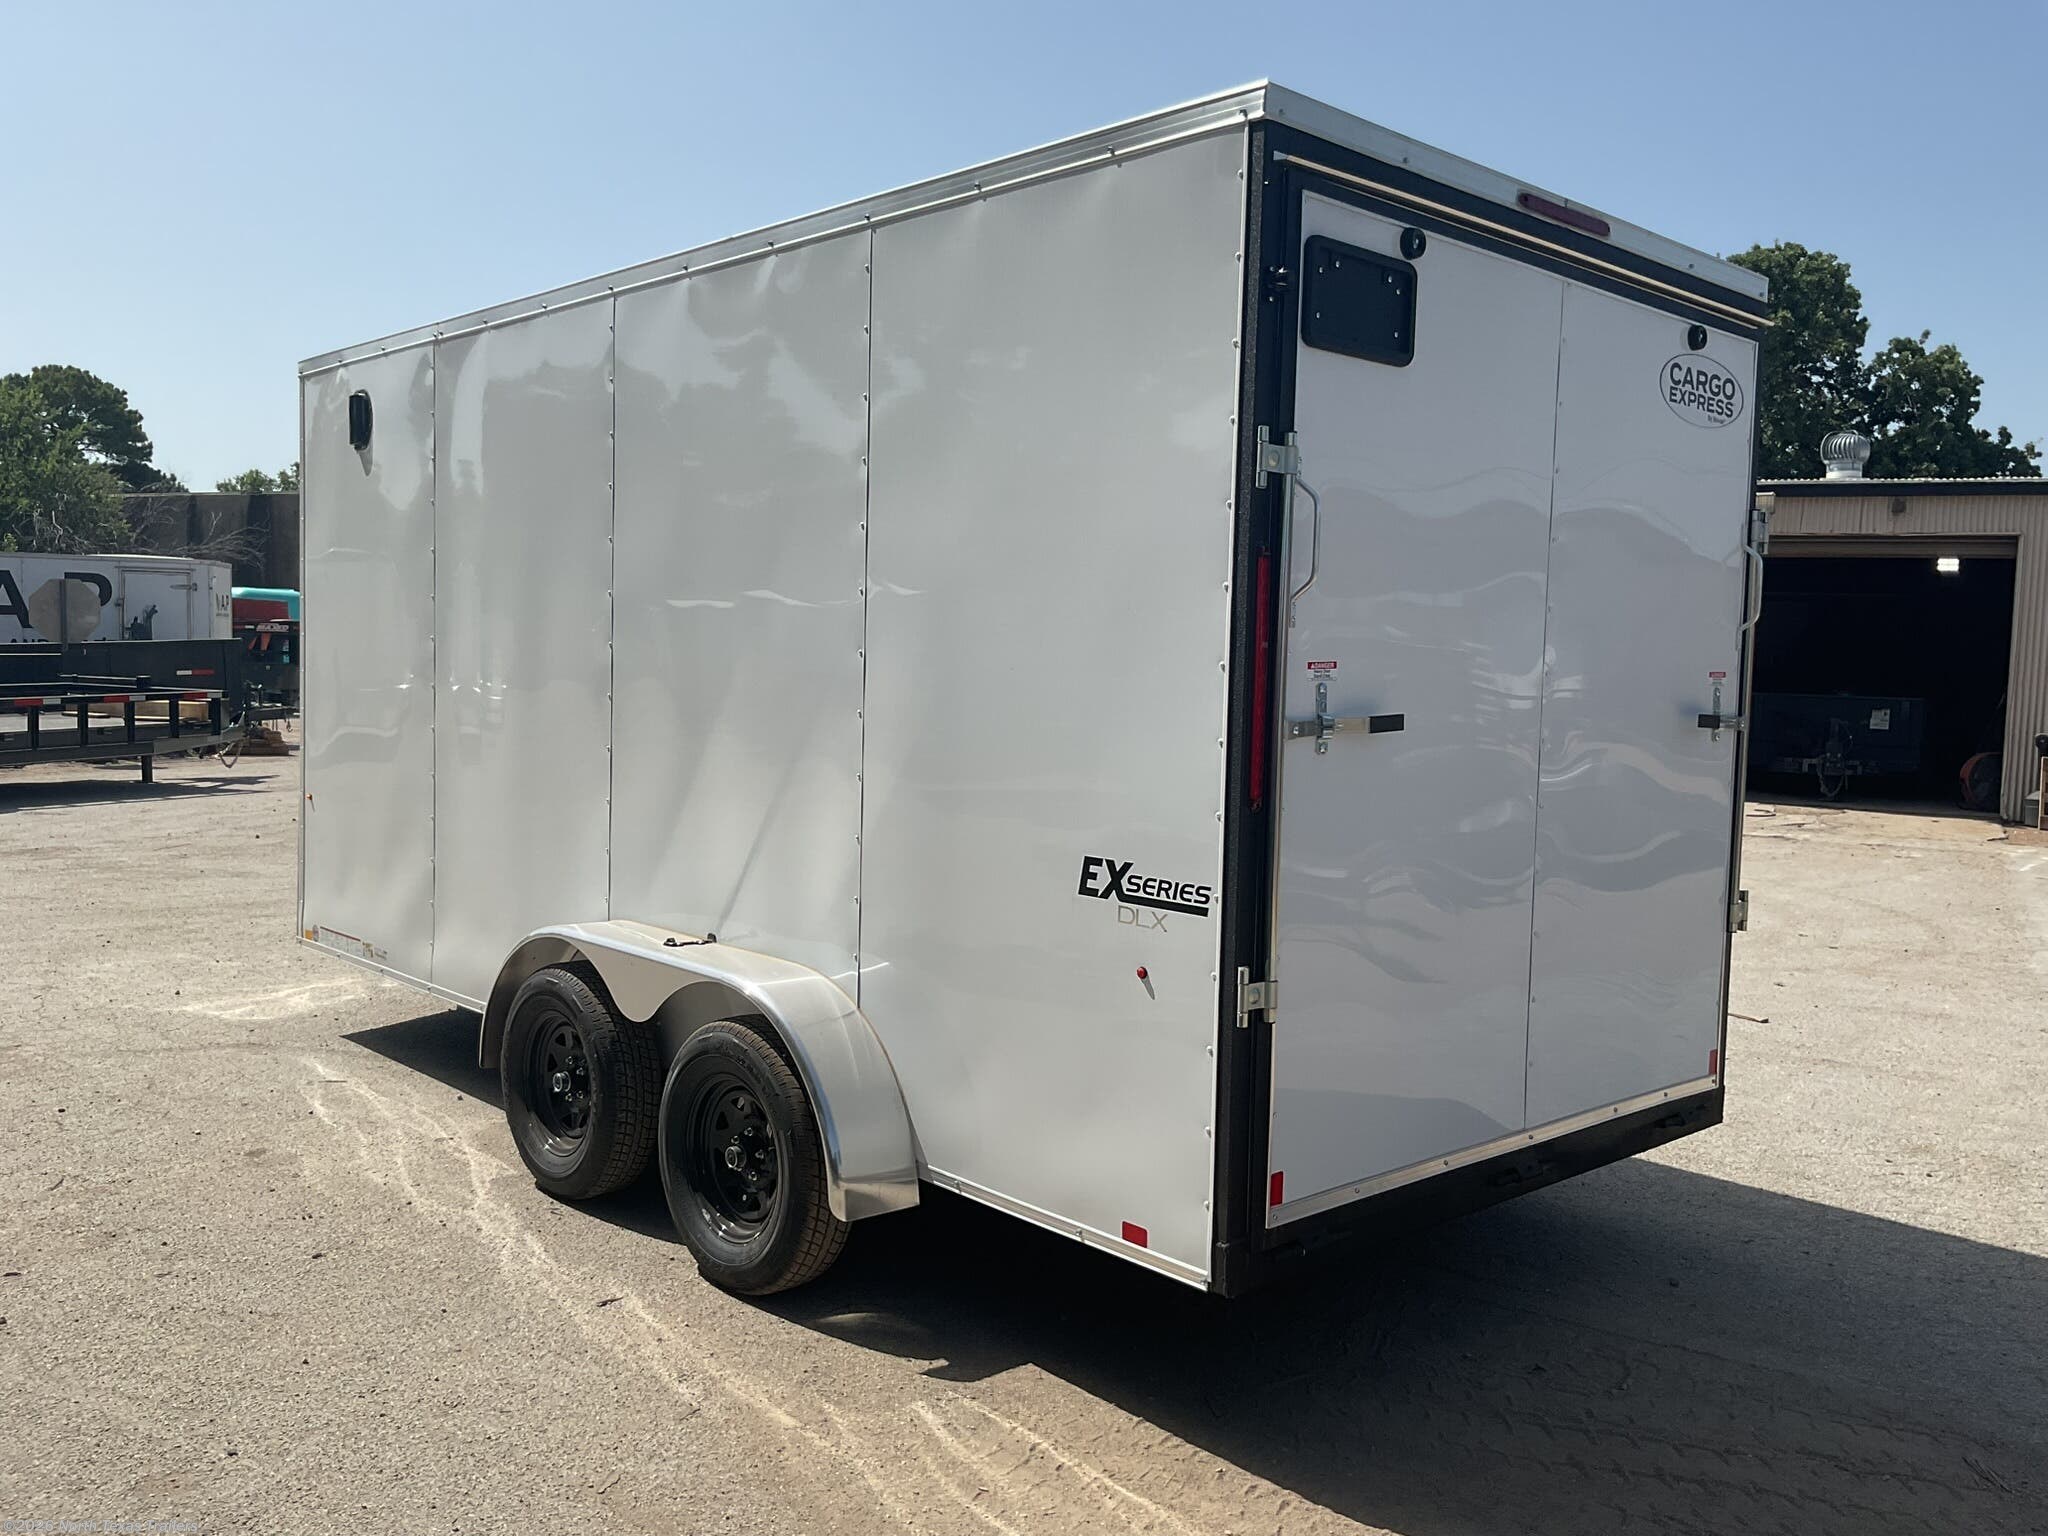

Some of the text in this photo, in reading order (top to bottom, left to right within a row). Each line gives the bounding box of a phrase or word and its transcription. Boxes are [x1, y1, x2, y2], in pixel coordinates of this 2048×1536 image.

[1669, 362, 1736, 401] CARGO
[1669, 385, 1734, 418] EXPRESS
[1117, 904, 1168, 933] DLX
